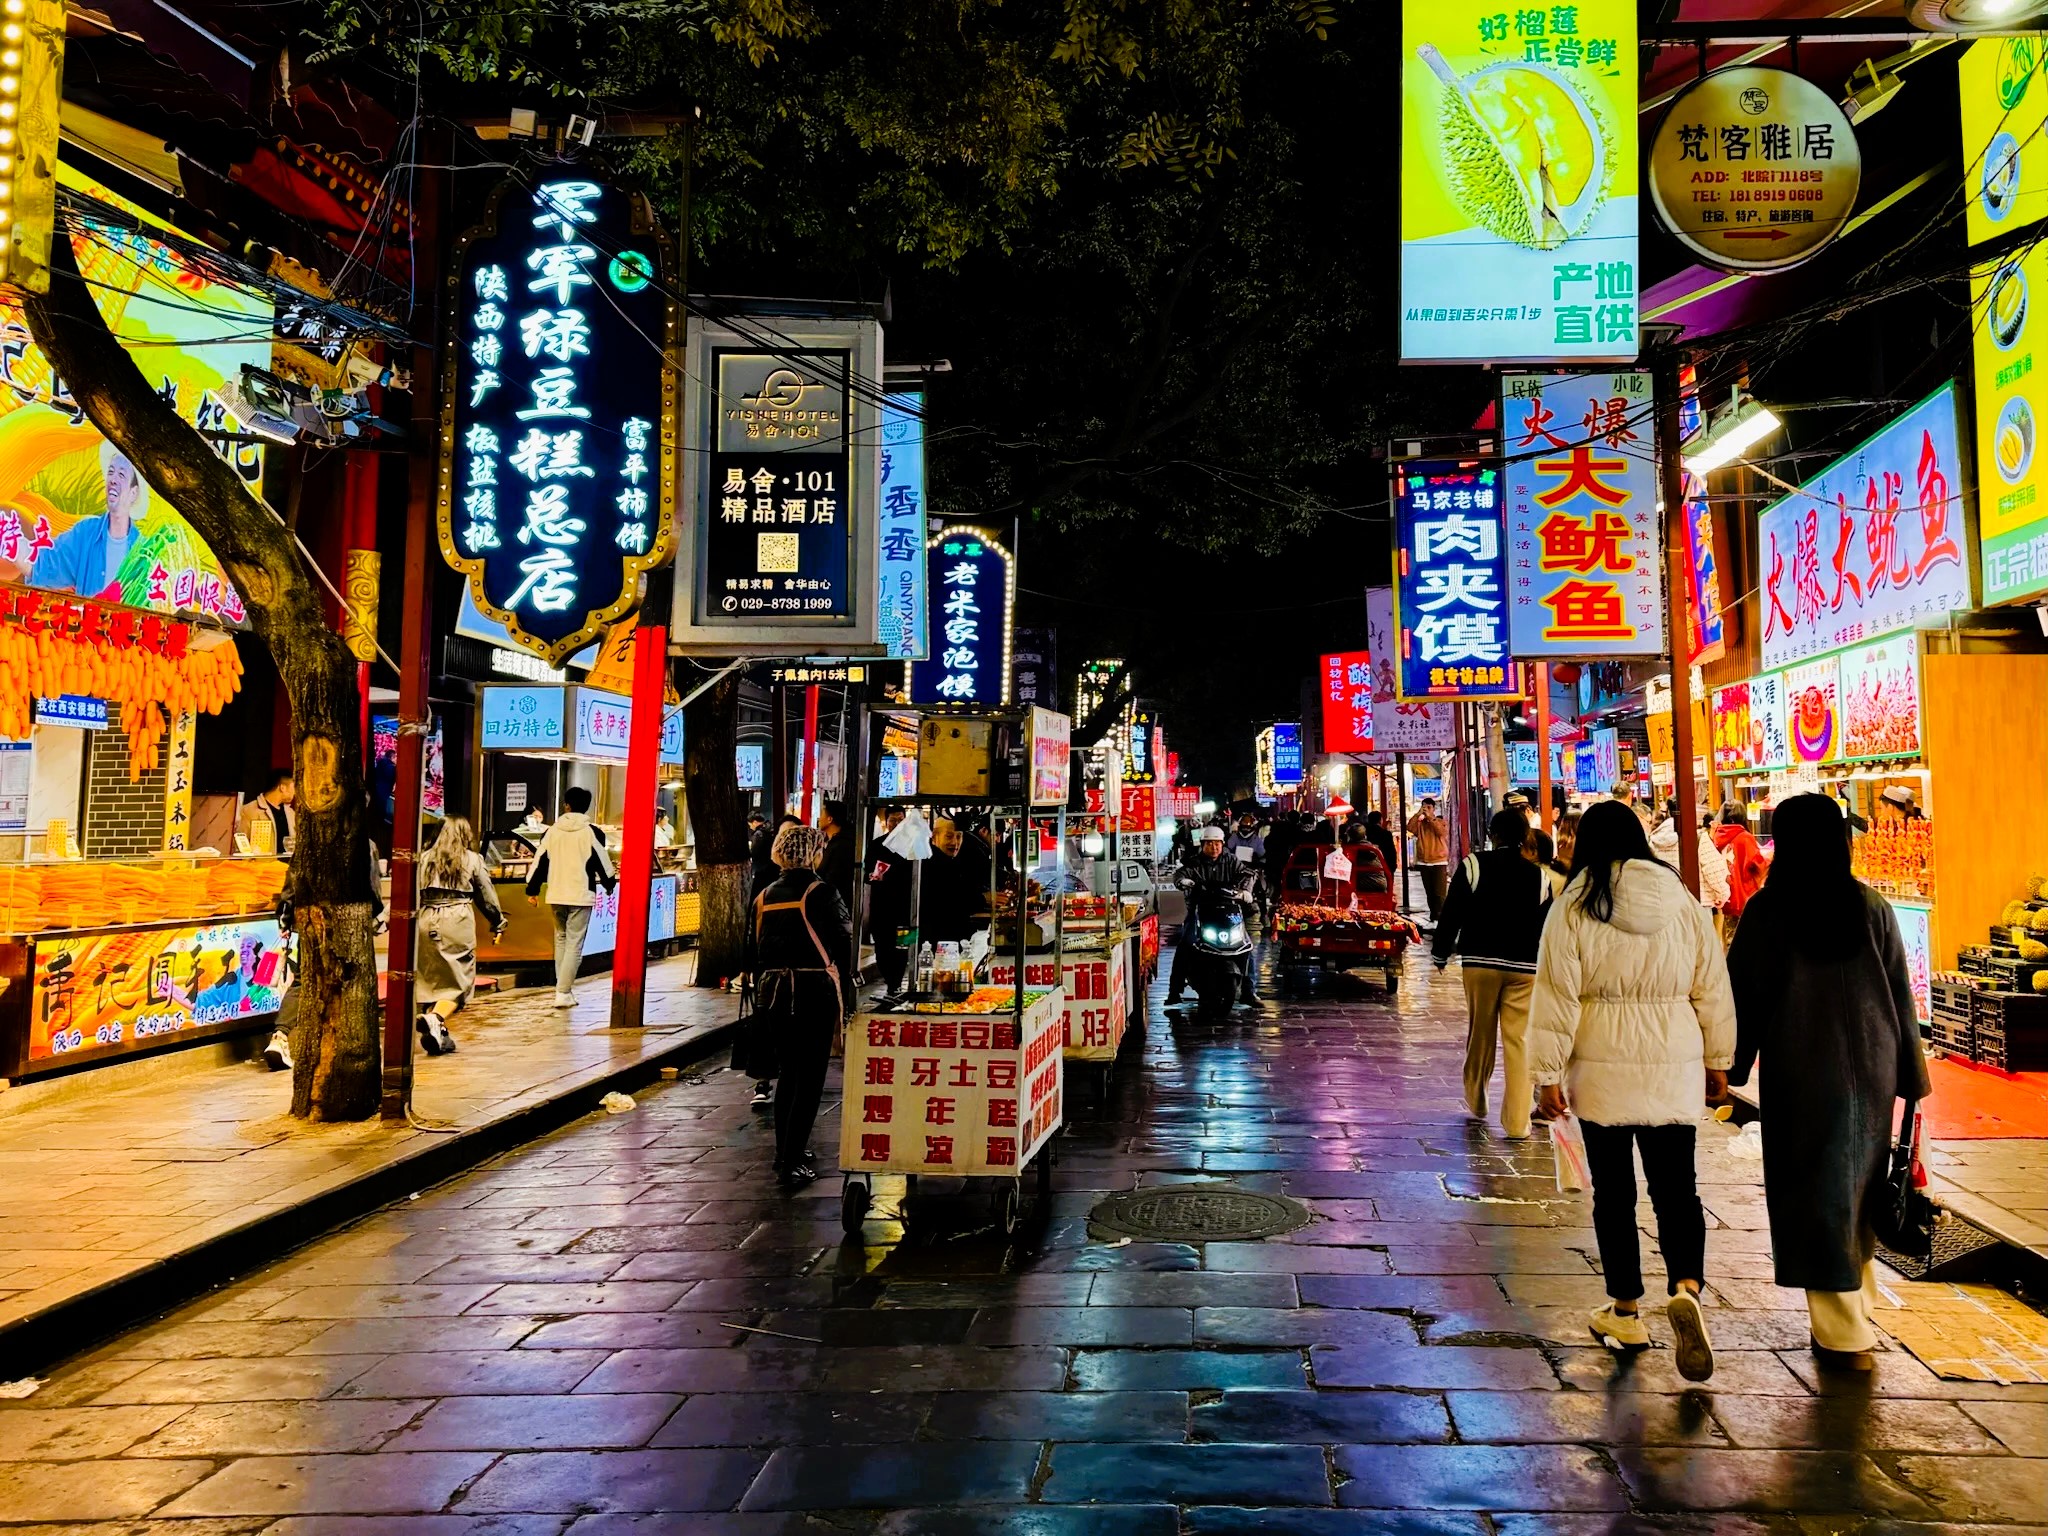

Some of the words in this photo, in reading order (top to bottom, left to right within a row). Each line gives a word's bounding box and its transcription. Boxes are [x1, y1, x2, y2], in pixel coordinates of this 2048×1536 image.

[1478, 6, 1578, 42] 好榴莲
[1524, 38, 1617, 68] 正尝鲜
[1691, 171, 1729, 183] ADD:
[1692, 190, 1720, 202] TEL:
[1730, 190, 1750, 202] 181
[1754, 190, 1786, 202] 8919
[1789, 189, 1823, 202] 0608
[1553, 262, 1633, 301] 产地
[1406, 306, 1542, 321] 从果园到舌尖只需1步
[1553, 304, 1633, 343] 直供
[470, 264, 508, 408] 陕西特产
[1512, 380, 1543, 397] 民族
[1613, 376, 1644, 394] 小吃
[783, 409, 840, 421] HOTEL
[1517, 396, 1639, 449] 火爆
[615, 417, 652, 554] 富平柿饼
[1412, 489, 1494, 511] 马家老铺
[721, 497, 837, 524] 精品酒店
[1515, 485, 1532, 606] 要想生活过得好
[1534, 442, 1637, 642] 大鱿鱼
[1764, 429, 1961, 644] 火爆大鱿鱼
[1634, 512, 1654, 632] 美味鱿鱼不可少
[803, 598, 832, 609] 1999
[1413, 514, 1504, 664] 肉夹馍
[936, 563, 980, 698] 老米家泡馍
[1329, 657, 1344, 701] 回坊记忆
[1348, 661, 1373, 740] 酸梅汤
[486, 718, 561, 737] 回坊特色
[1122, 846, 1152, 857] 烤玉米
[865, 1057, 1017, 1089] 狼牙土豆
[863, 1095, 1017, 1127] 炒年糕
[861, 1133, 1016, 1166] 炒凉粉
